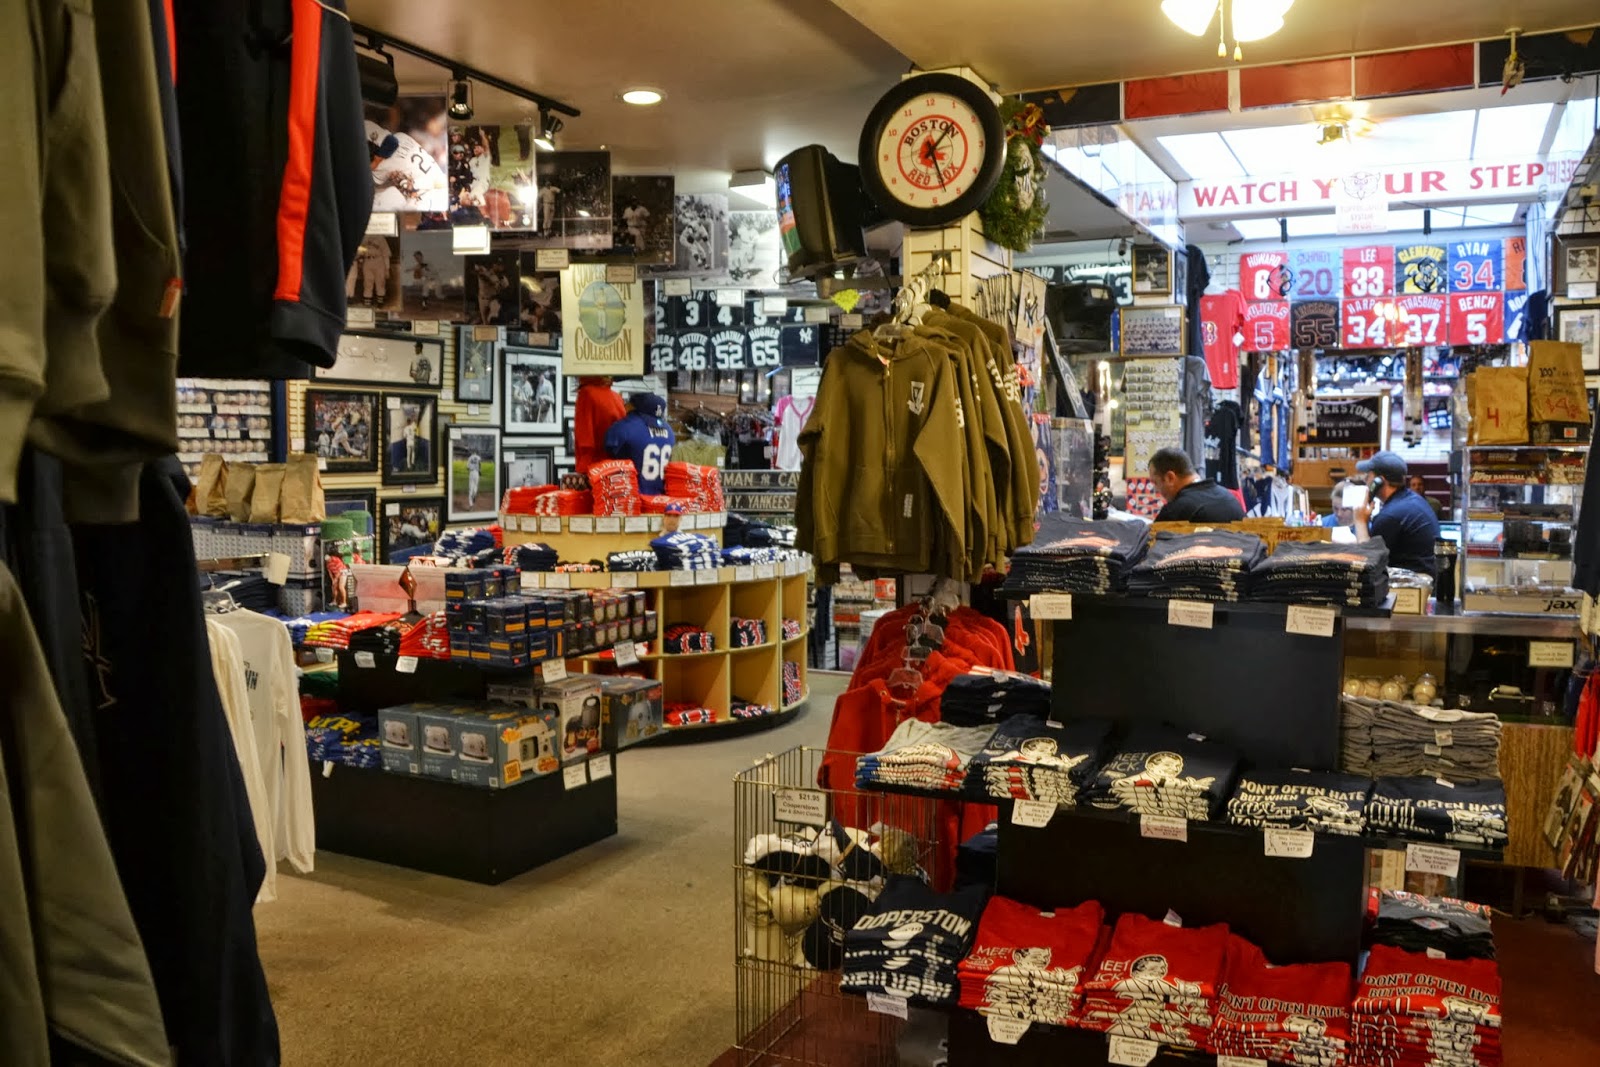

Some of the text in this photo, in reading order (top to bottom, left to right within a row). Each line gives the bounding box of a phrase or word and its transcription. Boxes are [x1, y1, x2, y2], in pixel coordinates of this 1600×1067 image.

[925, 98, 936, 107] 12
[903, 119, 960, 147] BOSTON
[907, 168, 931, 186] RED
[1193, 180, 1298, 208] WATCH
[1469, 163, 1544, 190] STEP
[1246, 247, 1282, 268] HOWARD
[1360, 248, 1378, 263] LEE
[1397, 245, 1446, 264] CLEMENTE
[1456, 241, 1491, 257] RYAN
[1296, 268, 1333, 296] 20
[1351, 265, 1385, 297] 33
[1453, 259, 1495, 290] 34
[685, 300, 700, 326] 3
[1457, 296, 1498, 312] BENCH
[748, 326, 780, 342] HUGHES
[1254, 320, 1275, 351] 5
[1295, 317, 1338, 349] 55
[1347, 315, 1387, 345] 34
[1403, 312, 1441, 343] 37
[1466, 312, 1488, 345] 5
[679, 346, 706, 371] 46
[715, 344, 745, 370] 52
[750, 340, 780, 367] 65
[1487, 407, 1499, 429] 4
[641, 443, 673, 481] 66
[747, 495, 791, 510] YANKEES
[1240, 791, 1264, 803] BUT
[1281, 784, 1326, 796] OFTEN
[1329, 789, 1367, 801] HATE
[1416, 799, 1465, 810] OFTEN
[1364, 972, 1413, 986] DON'T
[1414, 973, 1467, 996] OFTEN
[1368, 985, 1437, 998] BUT WHEN
[1258, 997, 1305, 1015] OFTEN
[1240, 1013, 1278, 1023] WHEN
